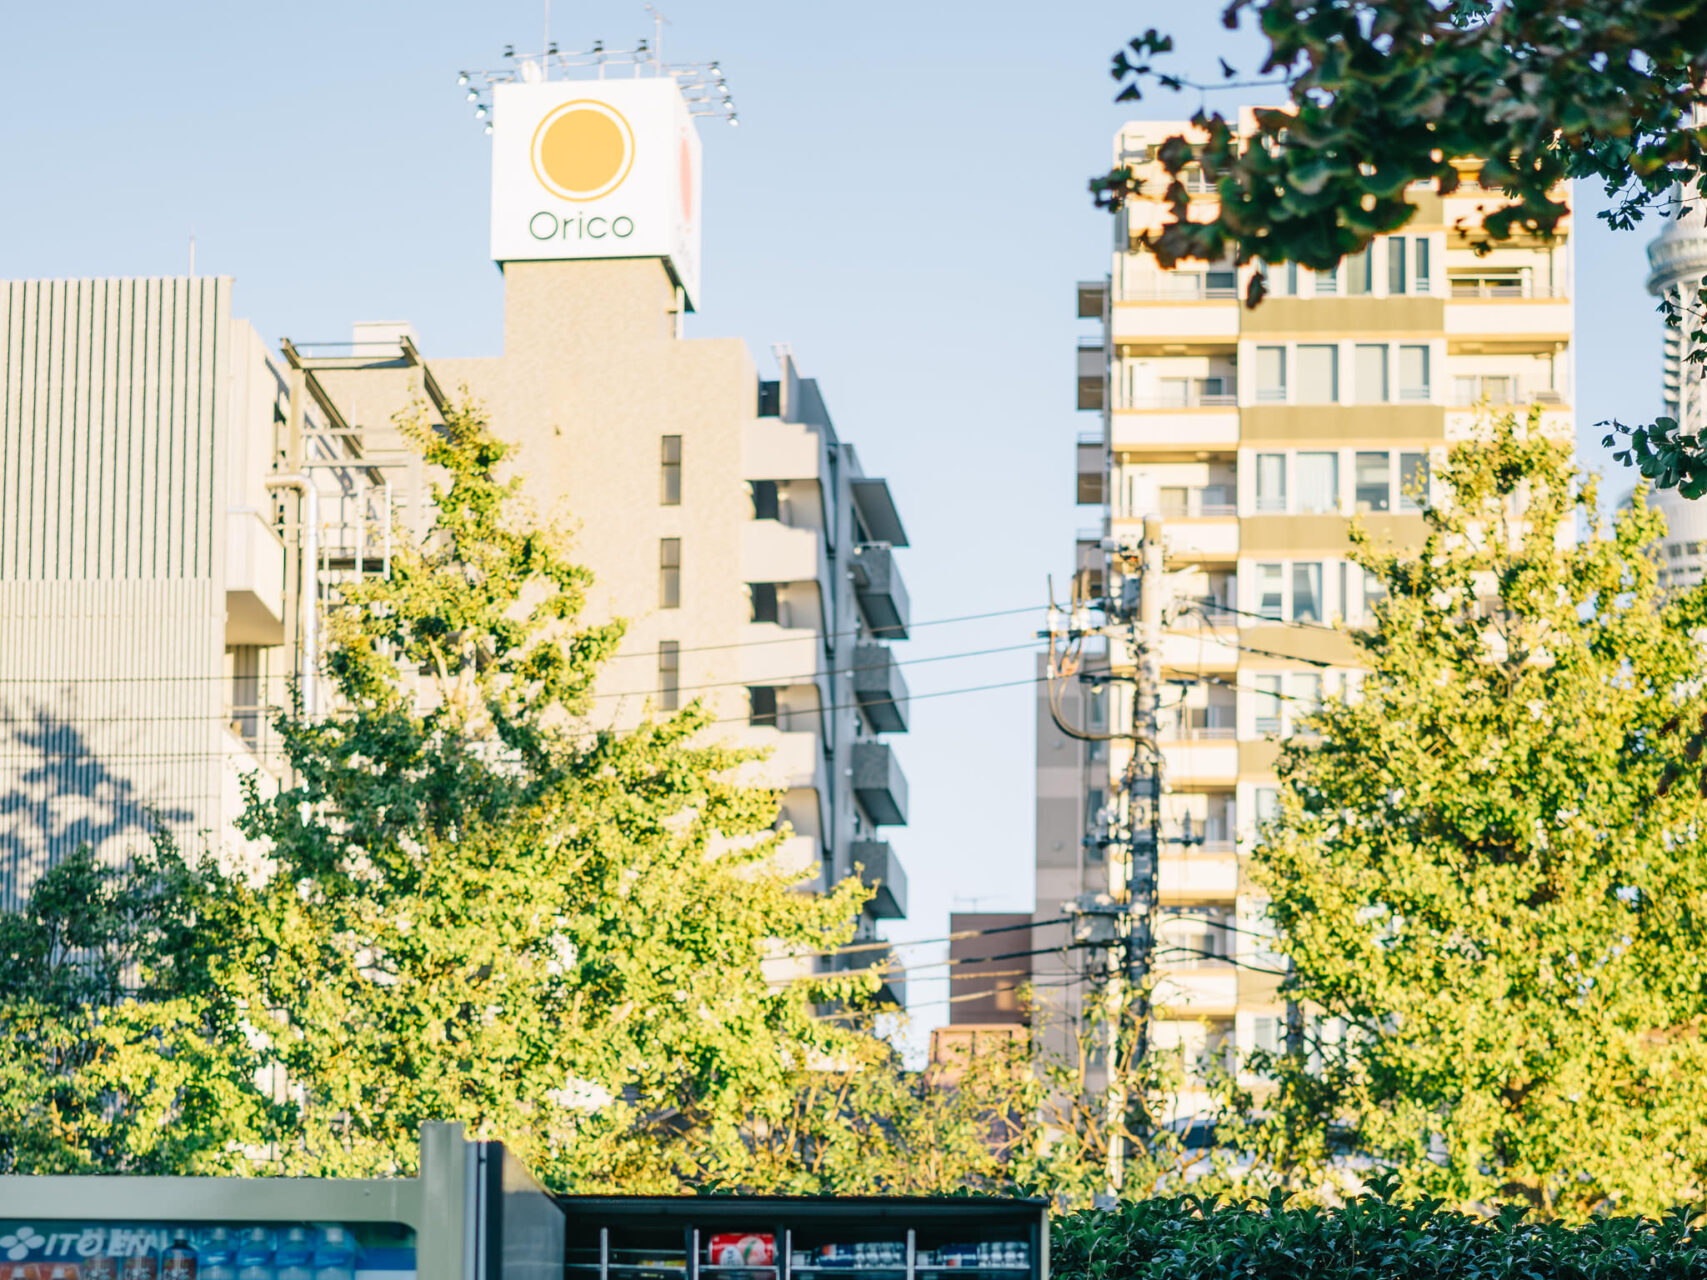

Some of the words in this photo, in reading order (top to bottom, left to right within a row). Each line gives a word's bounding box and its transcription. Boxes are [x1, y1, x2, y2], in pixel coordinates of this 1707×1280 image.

[529, 211, 635, 240] Orico
[44, 1233, 104, 1257] ITO
[107, 1234, 153, 1257] EN
